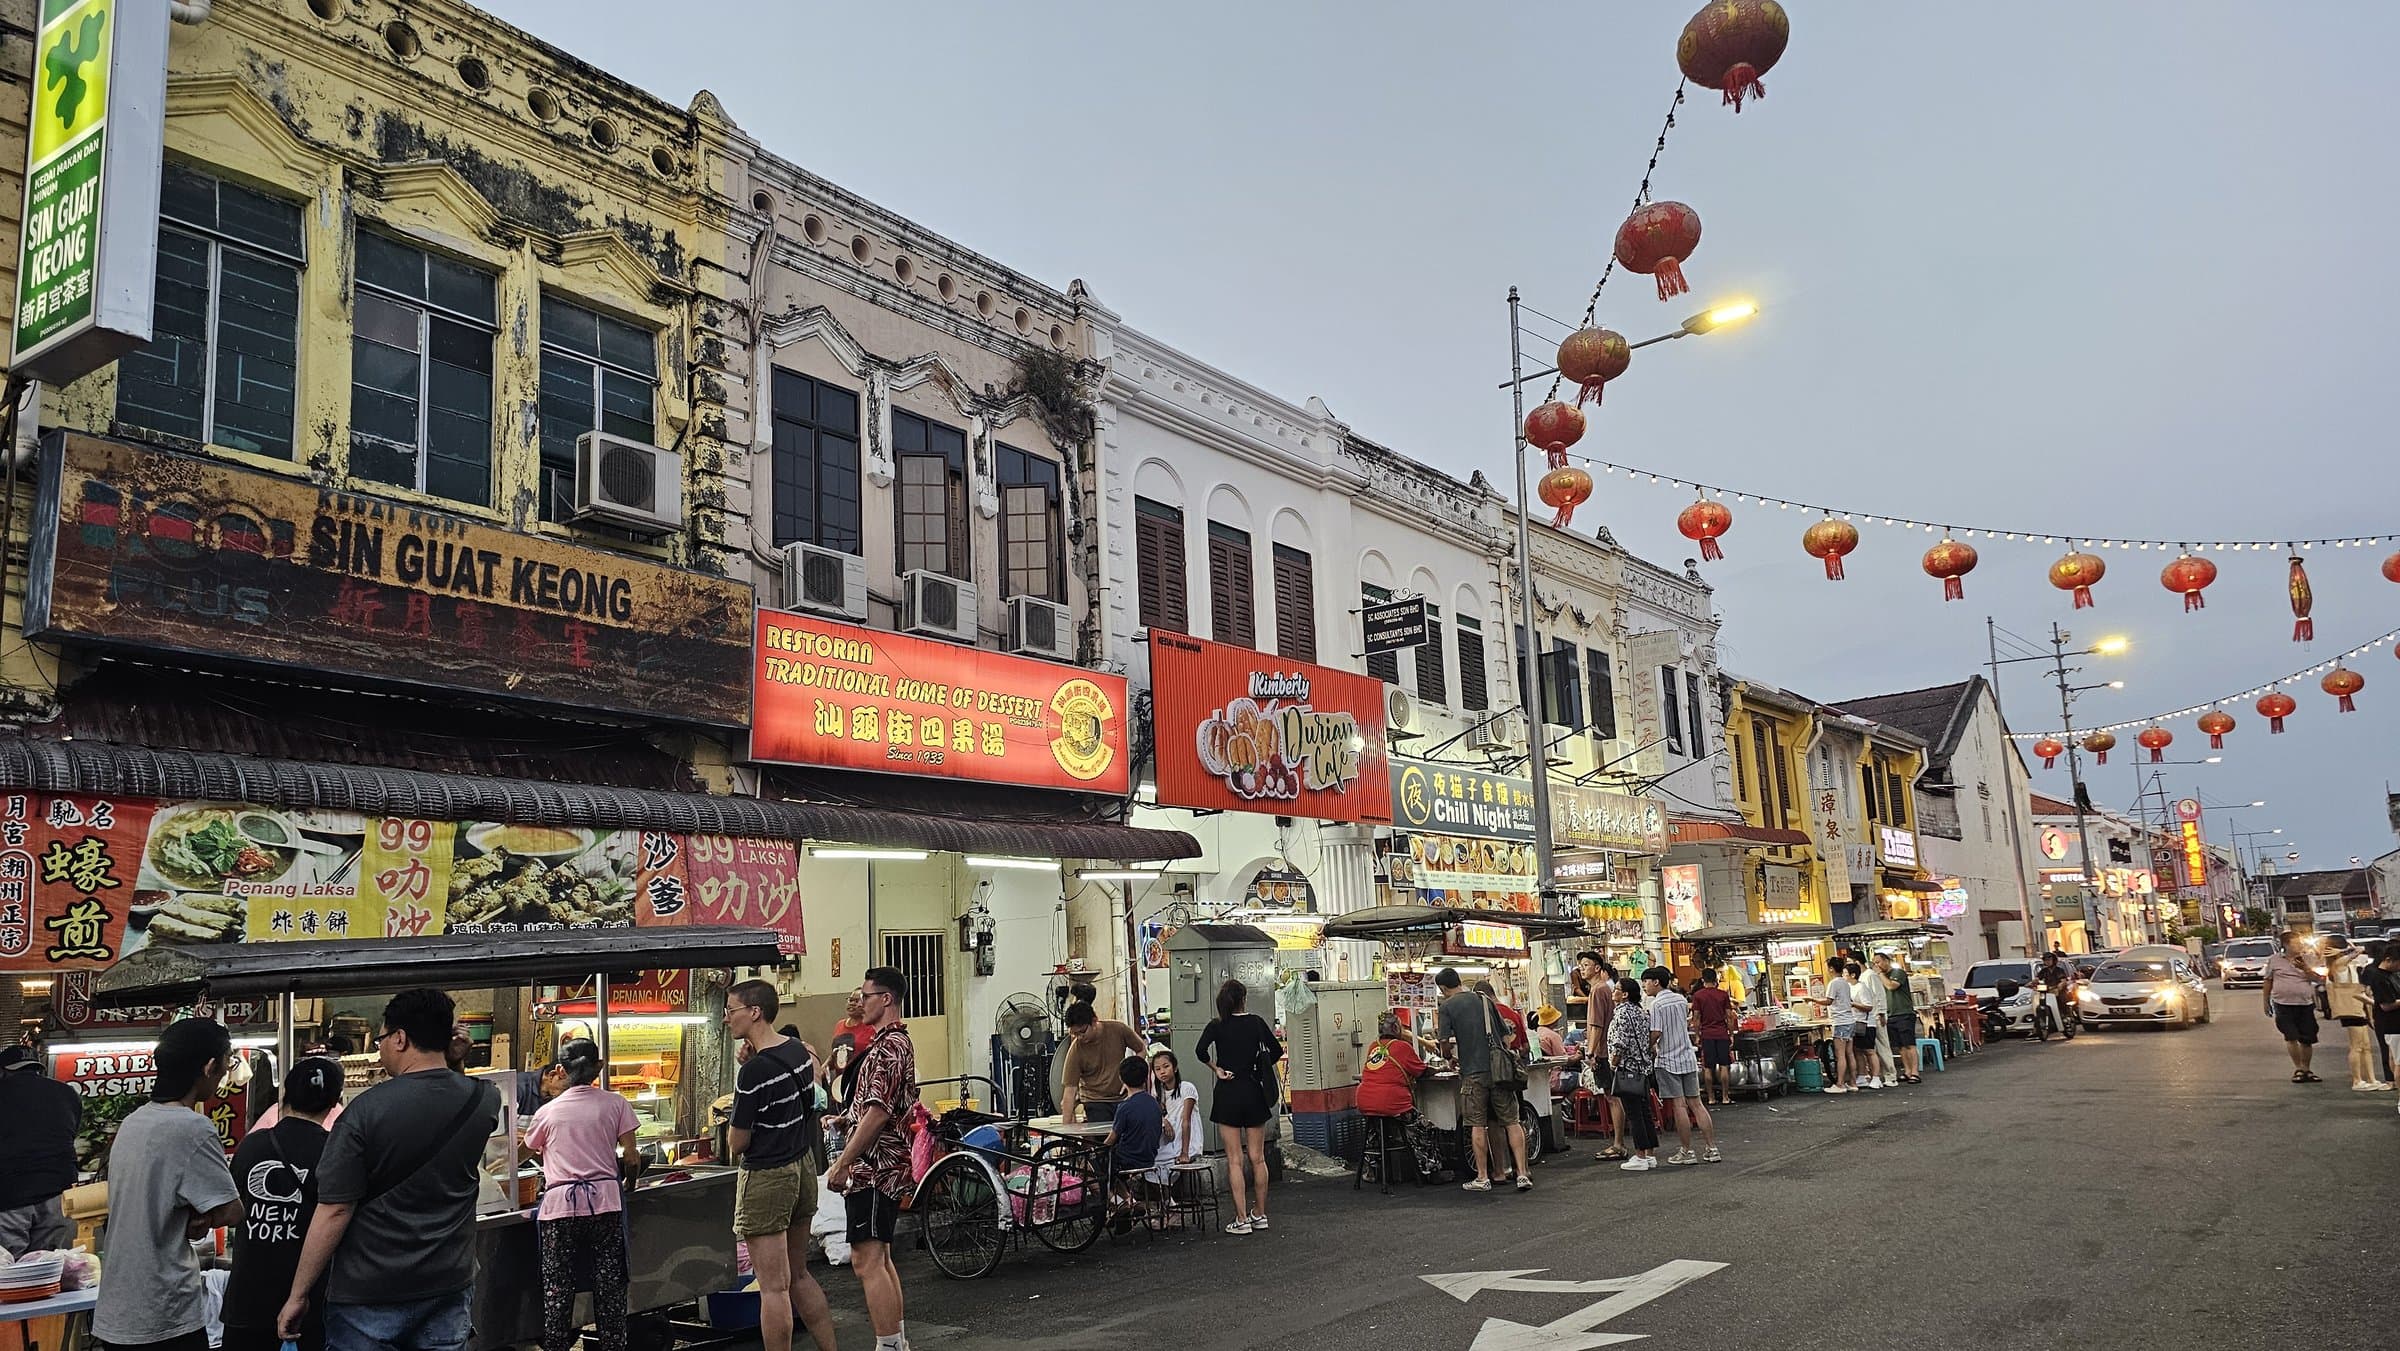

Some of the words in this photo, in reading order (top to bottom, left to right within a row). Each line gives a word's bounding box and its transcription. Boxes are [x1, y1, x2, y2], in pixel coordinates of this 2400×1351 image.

[34, 167, 56, 190] KEDAI
[56, 149, 83, 176] MAKAN
[83, 138, 99, 158] DAN
[33, 180, 58, 205] MINUM
[28, 203, 54, 251] SIN
[57, 175, 98, 232] GUAT
[30, 224, 87, 289] KEONG
[310, 515, 383, 577] SIN
[396, 533, 501, 598] GUAT
[510, 556, 632, 622] KEONG
[766, 623, 874, 665] RESTORAN
[765, 656, 891, 698] TRADITIONAL
[895, 677, 948, 706] HOME
[951, 686, 974, 709] OF
[977, 690, 1043, 719] DESSERT
[1251, 671, 1310, 701] Kimberly
[1283, 706, 1353, 764] Durian
[885, 746, 913, 762] Since
[917, 750, 945, 766] 1933
[1315, 742, 1349, 792] Café
[1406, 777, 1427, 814] 夜
[47, 799, 116, 830] 馳名
[1434, 798, 1469, 825] Chill
[1473, 803, 1512, 833] Night
[380, 817, 432, 852] 99
[690, 833, 735, 864] 99
[642, 831, 685, 917] 沙爹
[740, 849, 788, 867] LAKSA
[42, 837, 120, 960] 蠔煎
[225, 880, 298, 898] Penang
[302, 882, 357, 897] Laksa
[694, 868, 799, 928] 叻沙
[2055, 895, 2079, 905] GAS
[250, 1202, 298, 1222] NEW
[246, 1219, 300, 1243] YORK
